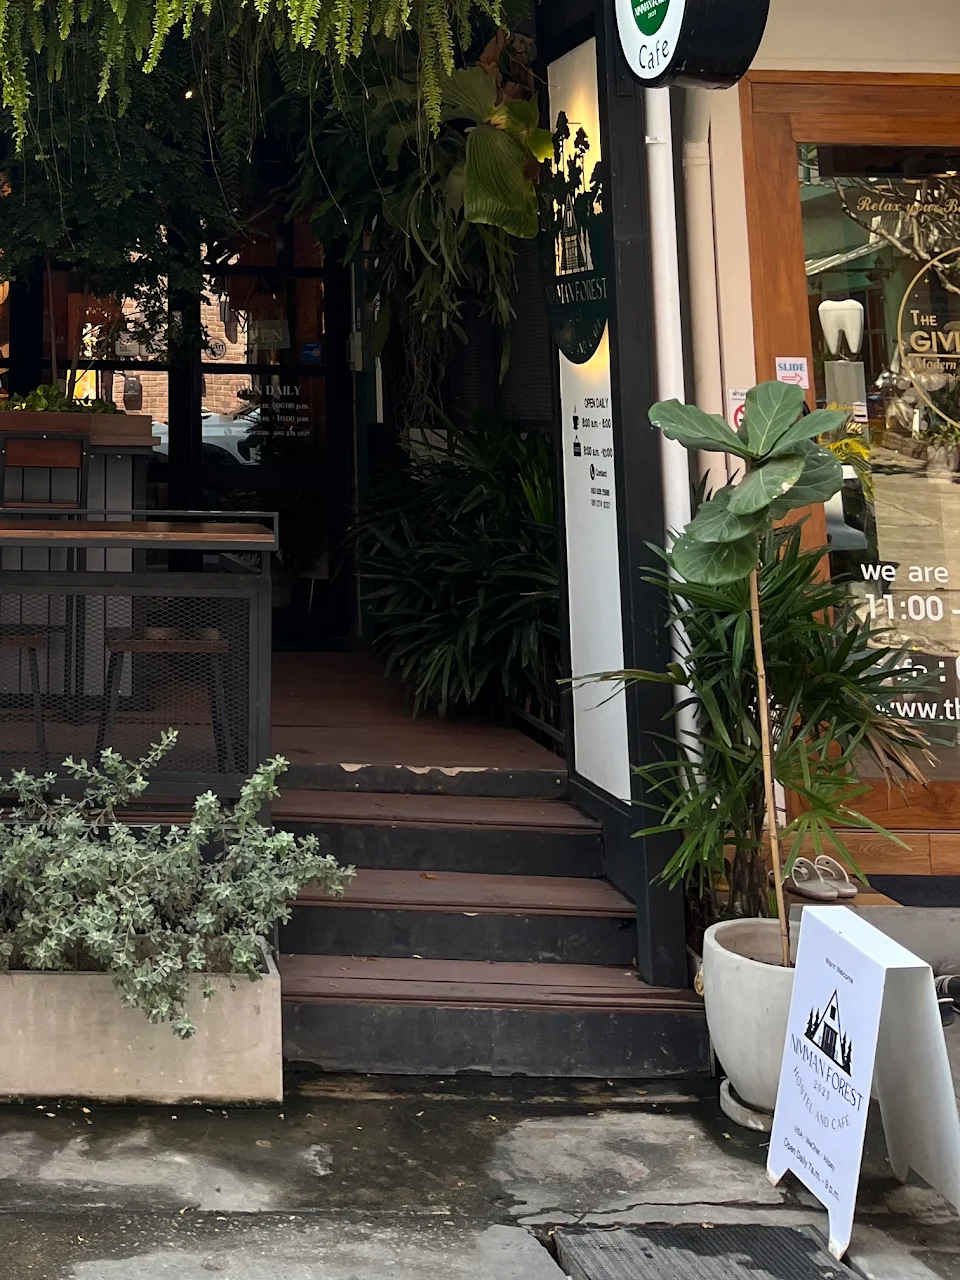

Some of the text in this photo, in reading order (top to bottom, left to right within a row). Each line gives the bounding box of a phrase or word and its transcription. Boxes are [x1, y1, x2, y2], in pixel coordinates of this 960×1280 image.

[638, 39, 669, 70] Cafe
[856, 196, 901, 212] Relax
[575, 277, 607, 301] FOREST
[778, 363, 805, 372] SLIDE
[915, 358, 956, 370] Modern
[266, 385, 302, 396] DAILY
[584, 398, 595, 408] OPEN
[860, 563, 949, 583] we are
[865, 593, 944, 621] 11:00
[790, 1033, 864, 1111] NIMMAN FOREST
[793, 1066, 851, 1130] HOSTEL AND CAFE
[813, 1080, 830, 1101] 2023
[783, 1137, 796, 1156] Open
[796, 1149, 808, 1169] Daily
